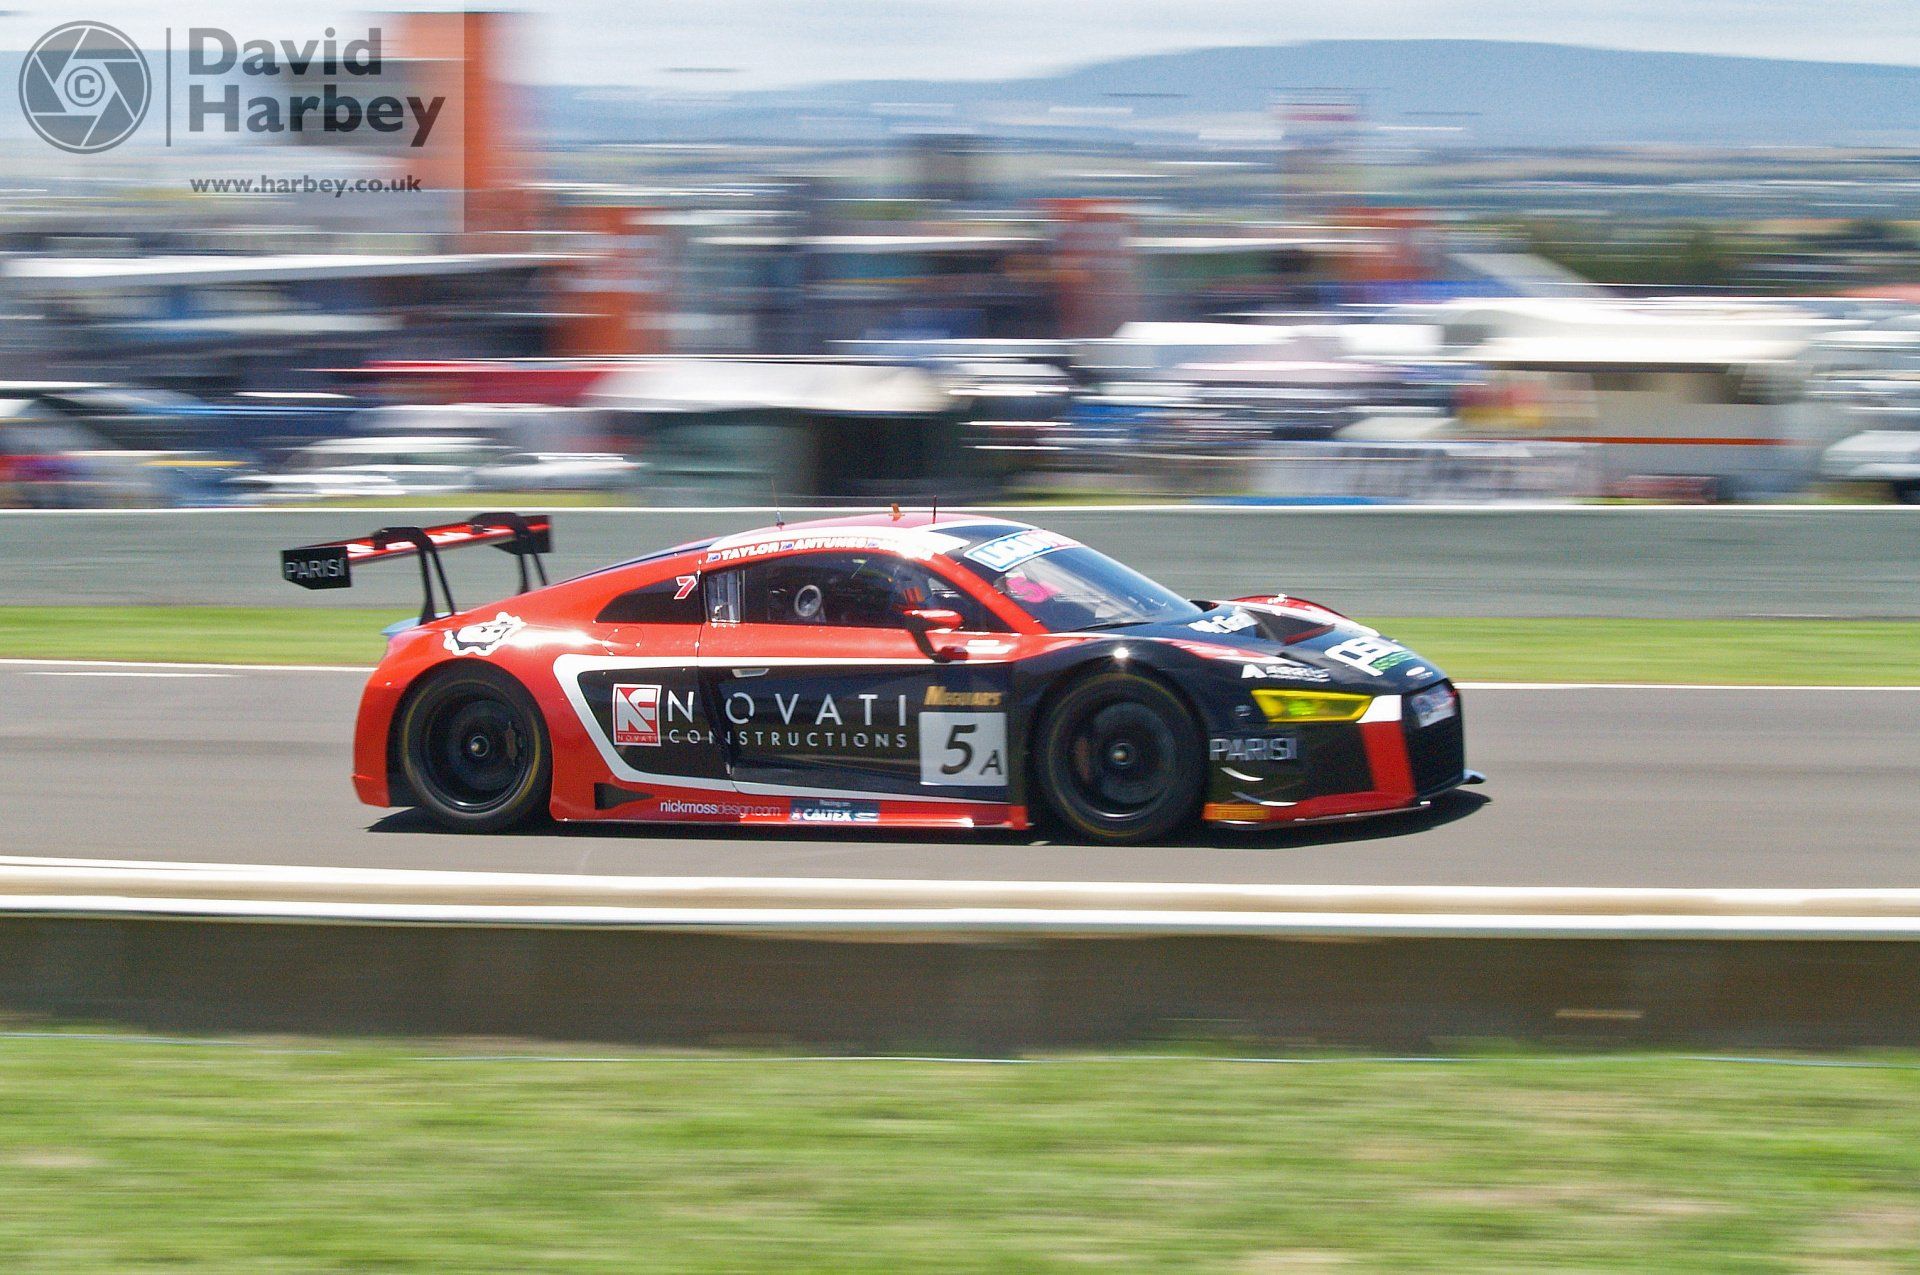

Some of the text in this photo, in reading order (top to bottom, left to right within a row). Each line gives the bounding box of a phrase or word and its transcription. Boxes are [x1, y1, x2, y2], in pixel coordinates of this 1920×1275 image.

[721, 542, 779, 560] TAYLOR
[284, 557, 346, 580] PARISI
[673, 575, 697, 600] 7
[667, 690, 907, 726] NOVATI
[668, 729, 907, 748] CONSTRUCTIONS
[1209, 738, 1297, 761] PARISI
[660, 799, 782, 819] nickmossdesign.com
[803, 808, 853, 821] CALTEX
